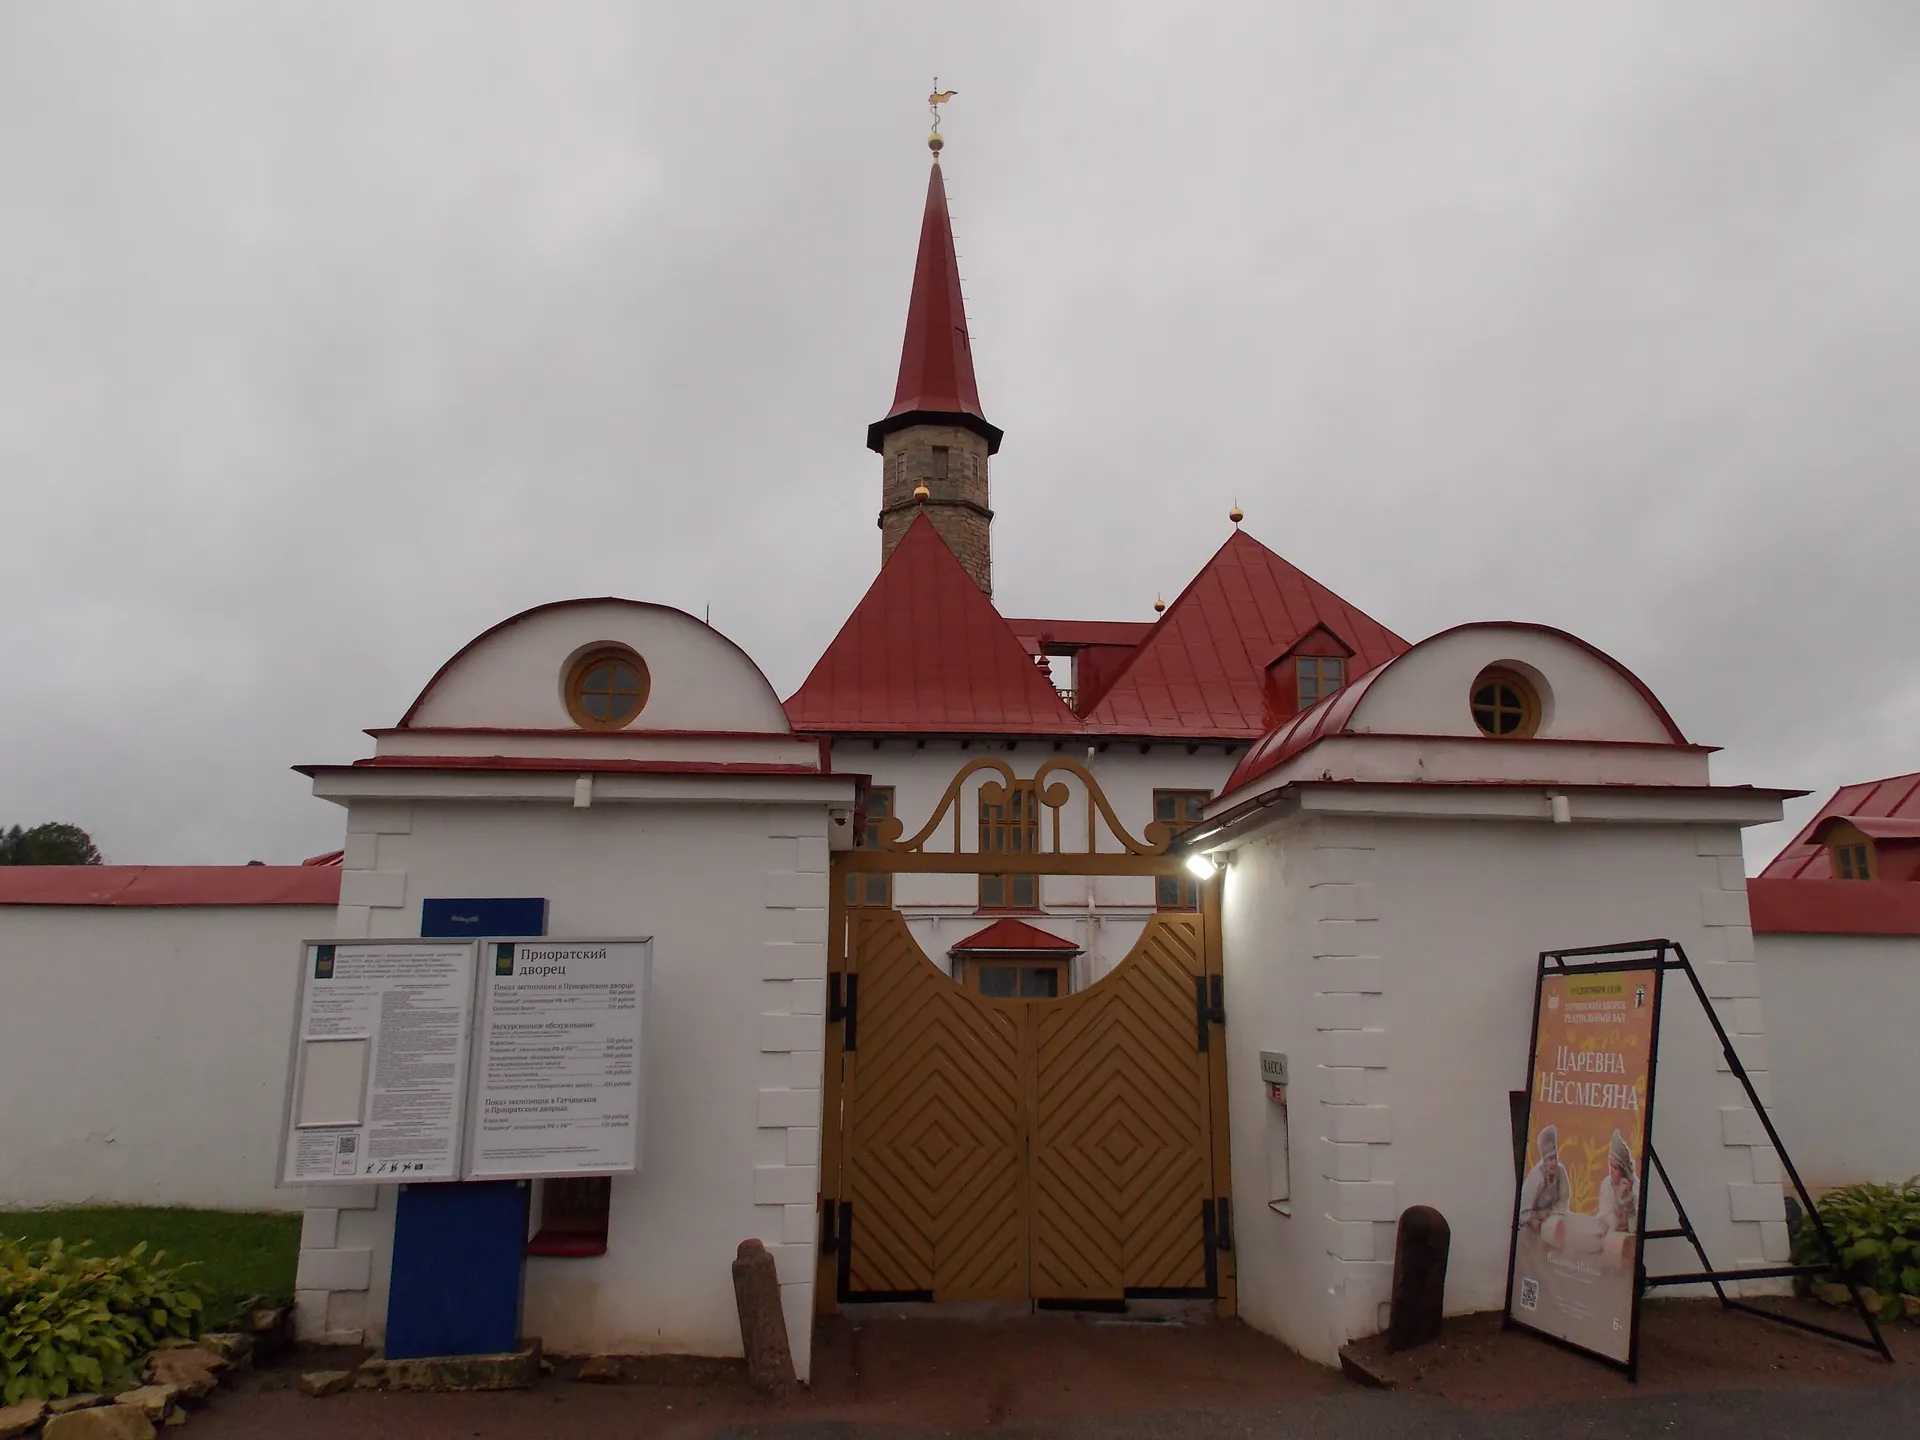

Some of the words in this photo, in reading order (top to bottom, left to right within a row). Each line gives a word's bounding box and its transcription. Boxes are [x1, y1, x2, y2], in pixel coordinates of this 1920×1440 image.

[521, 948, 607, 962] Приоратский
[519, 965, 566, 976] дворец
[494, 983, 515, 991] Показ
[517, 983, 556, 991] экспозиции
[563, 982, 608, 991] Приоратском
[609, 982, 634, 990] дворце
[492, 1022, 544, 1030] Экскурсионное
[545, 1021, 596, 1030] обслуживание:
[1556, 1045, 1626, 1076] ЦАРЕВНА
[1263, 1059, 1283, 1075] КАССА
[1540, 1071, 1640, 1112] НЕСМЕЯНА
[508, 1098, 550, 1106] экспозиции
[556, 1096, 597, 1104] Гатчинском
[491, 1106, 538, 1114] Приоратском
